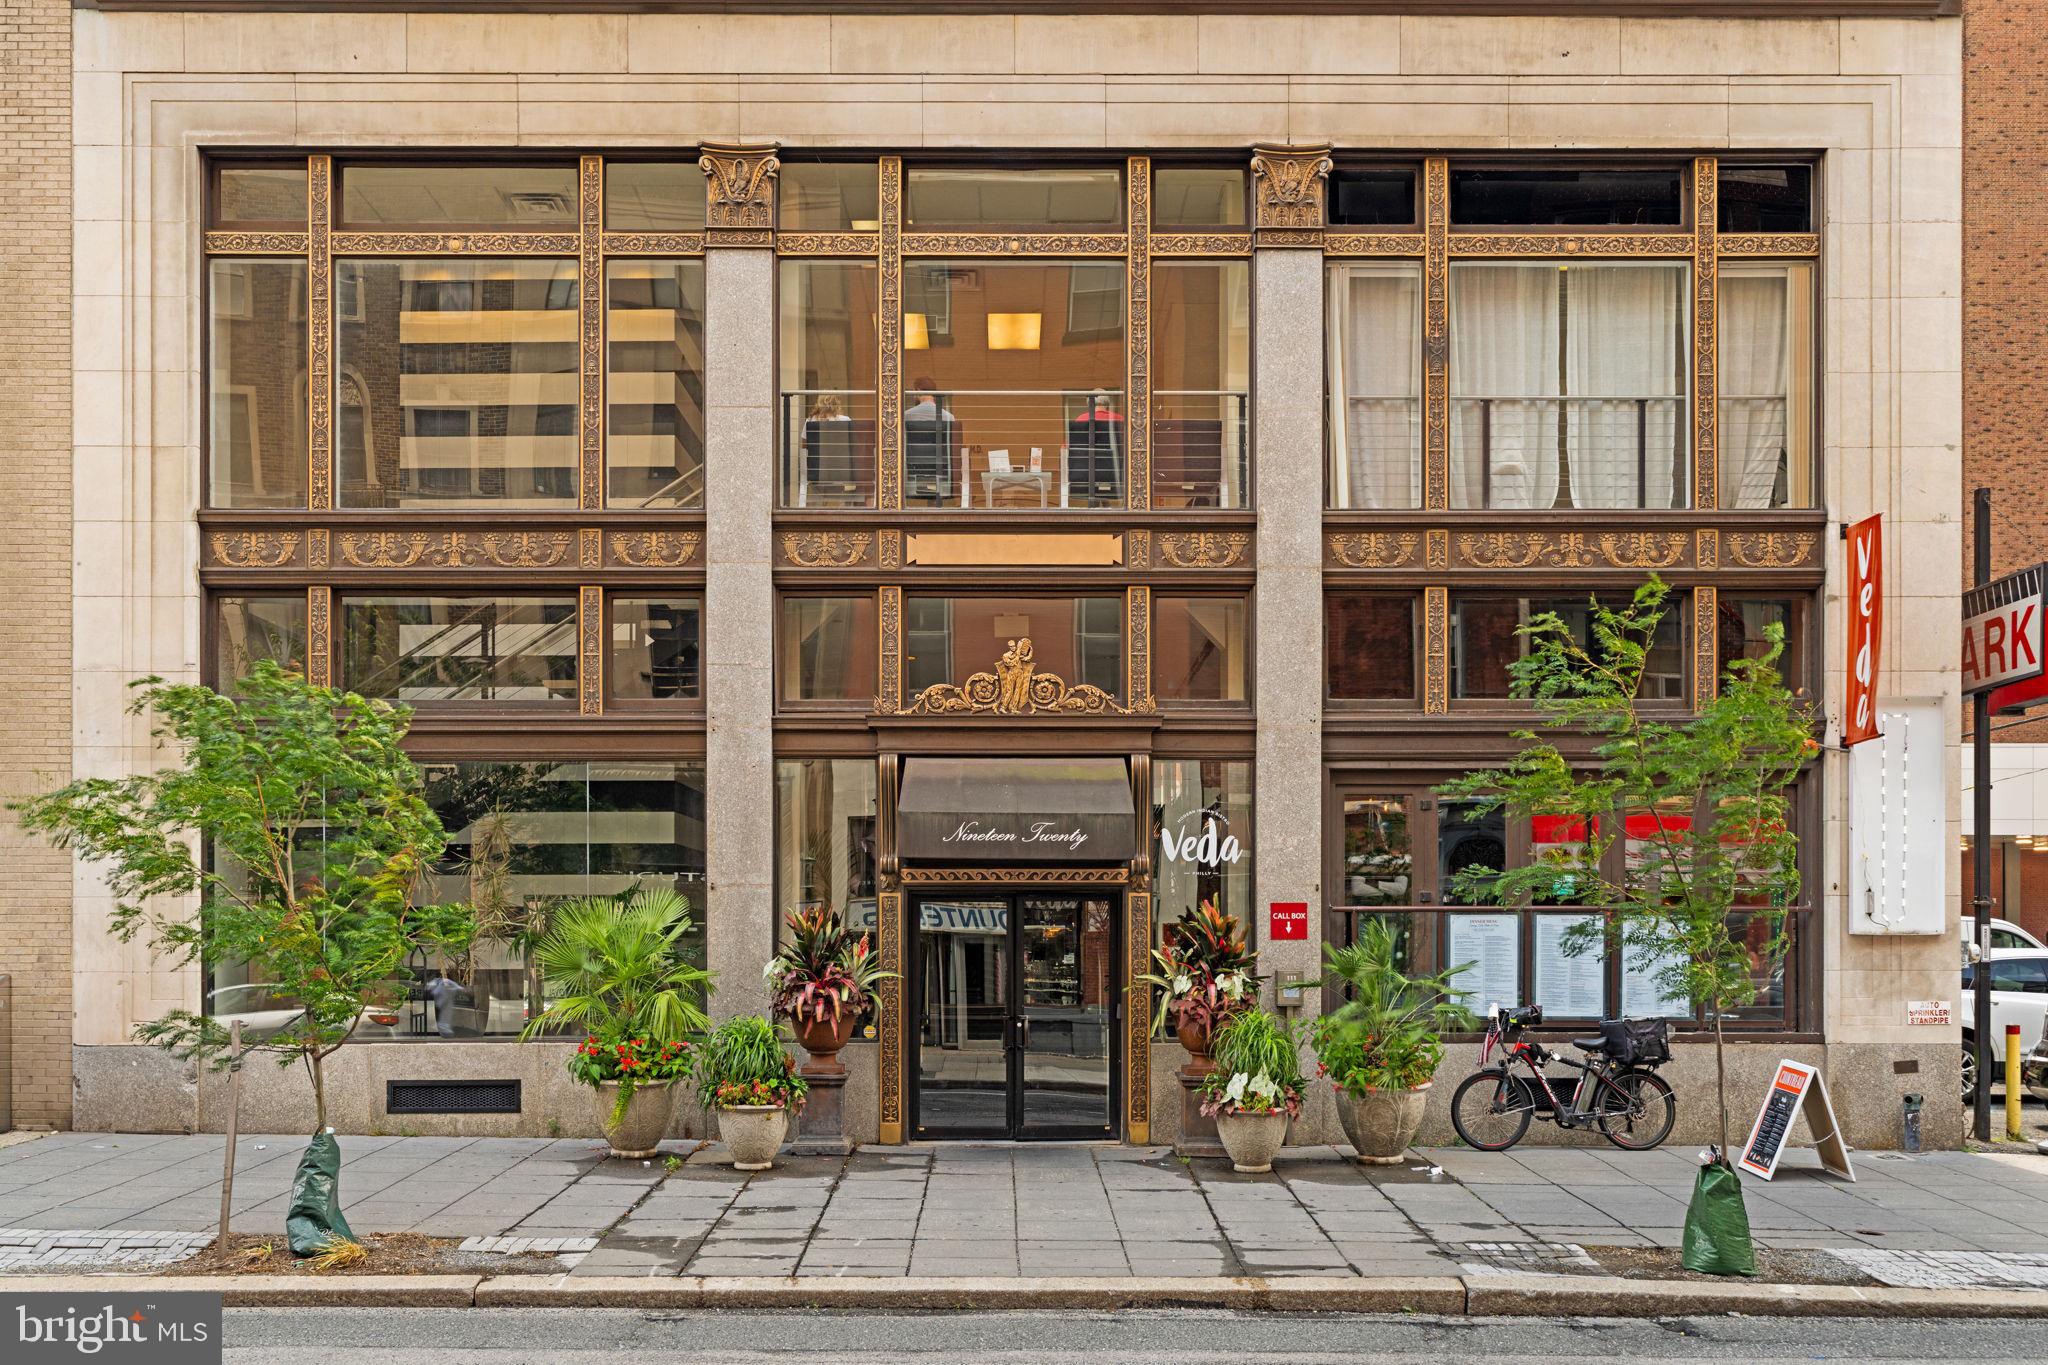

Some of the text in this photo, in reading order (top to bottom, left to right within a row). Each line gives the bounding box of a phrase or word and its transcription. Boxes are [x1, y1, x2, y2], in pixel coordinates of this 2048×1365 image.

[942, 821, 1088, 851] Nineteen Twenty
[1161, 816, 1243, 868] Veda
[1272, 912, 1306, 920] CALL BOX
[1910, 1017, 1949, 1025] STANDPIPE
